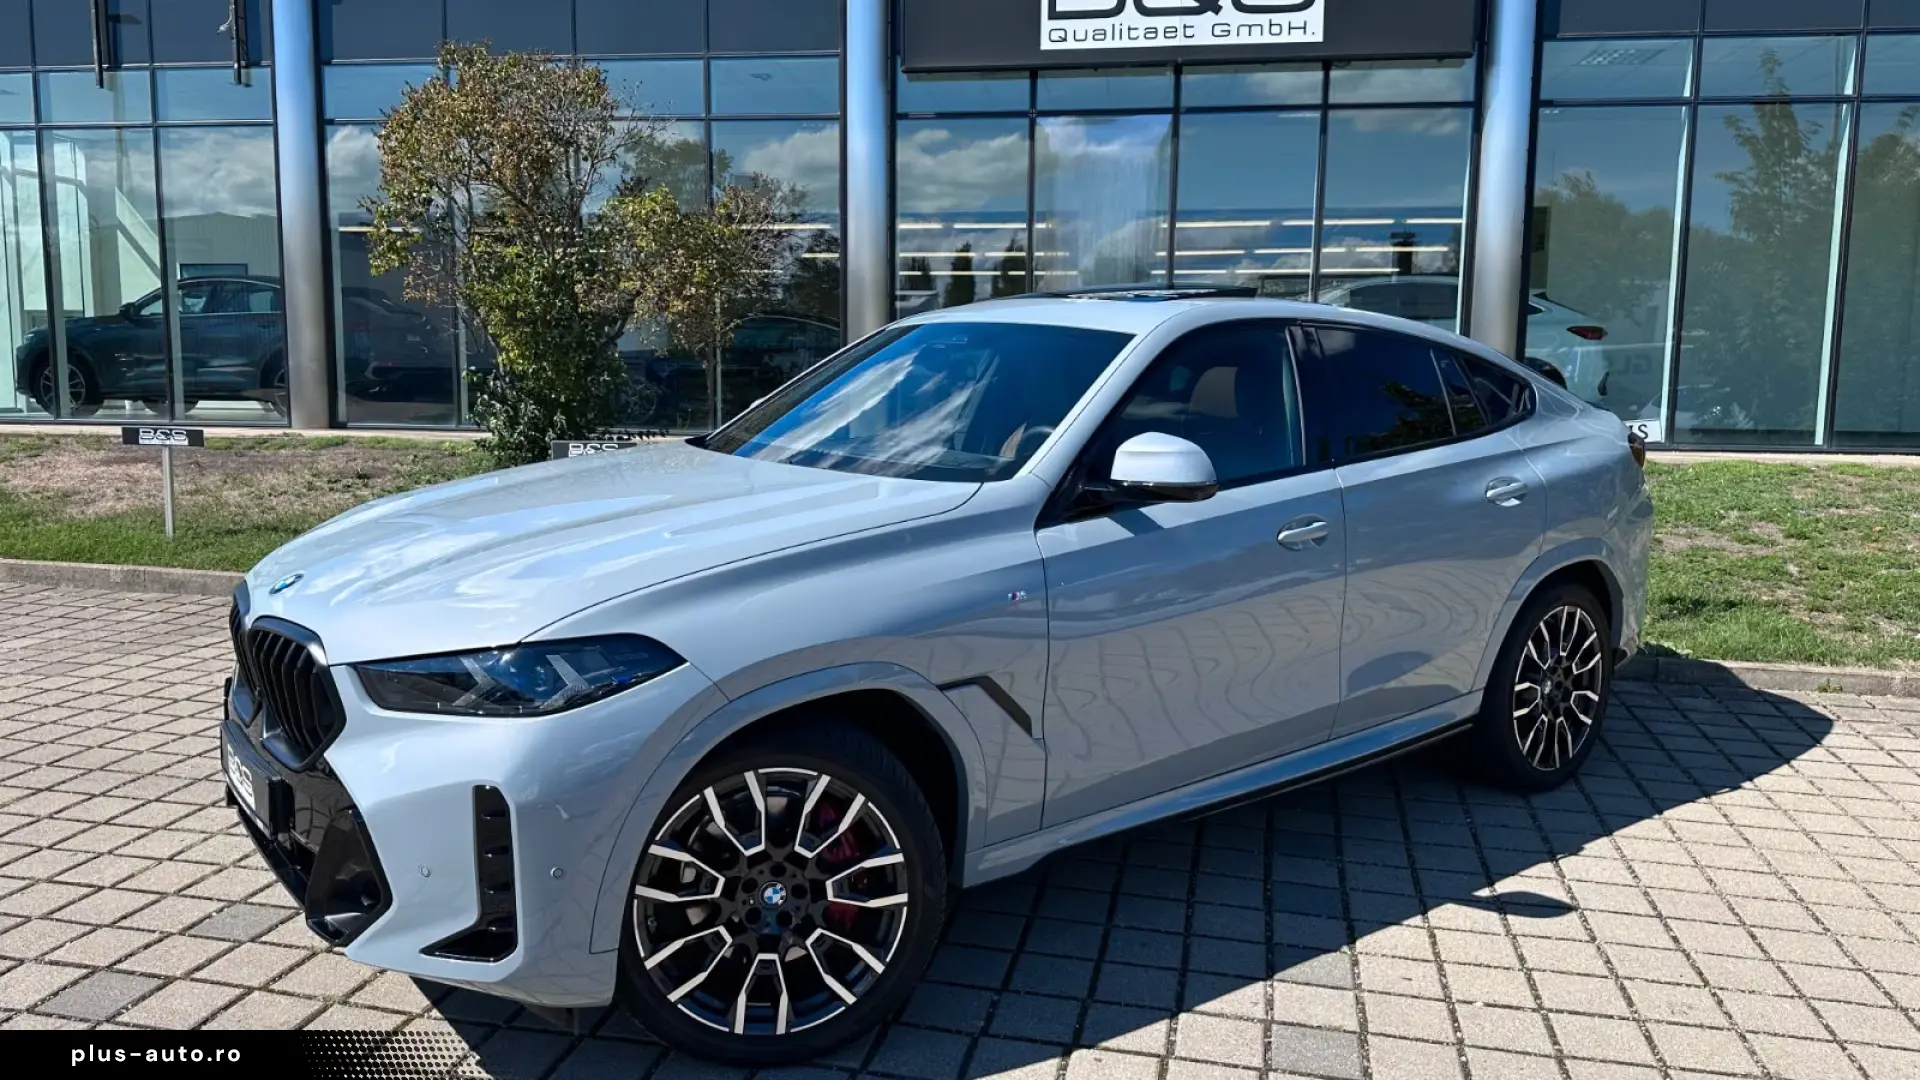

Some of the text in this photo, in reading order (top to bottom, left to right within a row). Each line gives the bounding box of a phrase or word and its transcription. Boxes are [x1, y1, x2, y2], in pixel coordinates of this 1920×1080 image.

[1048, 18, 1315, 43] Qualitaet GmbH.
[139, 428, 187, 440] B&S
